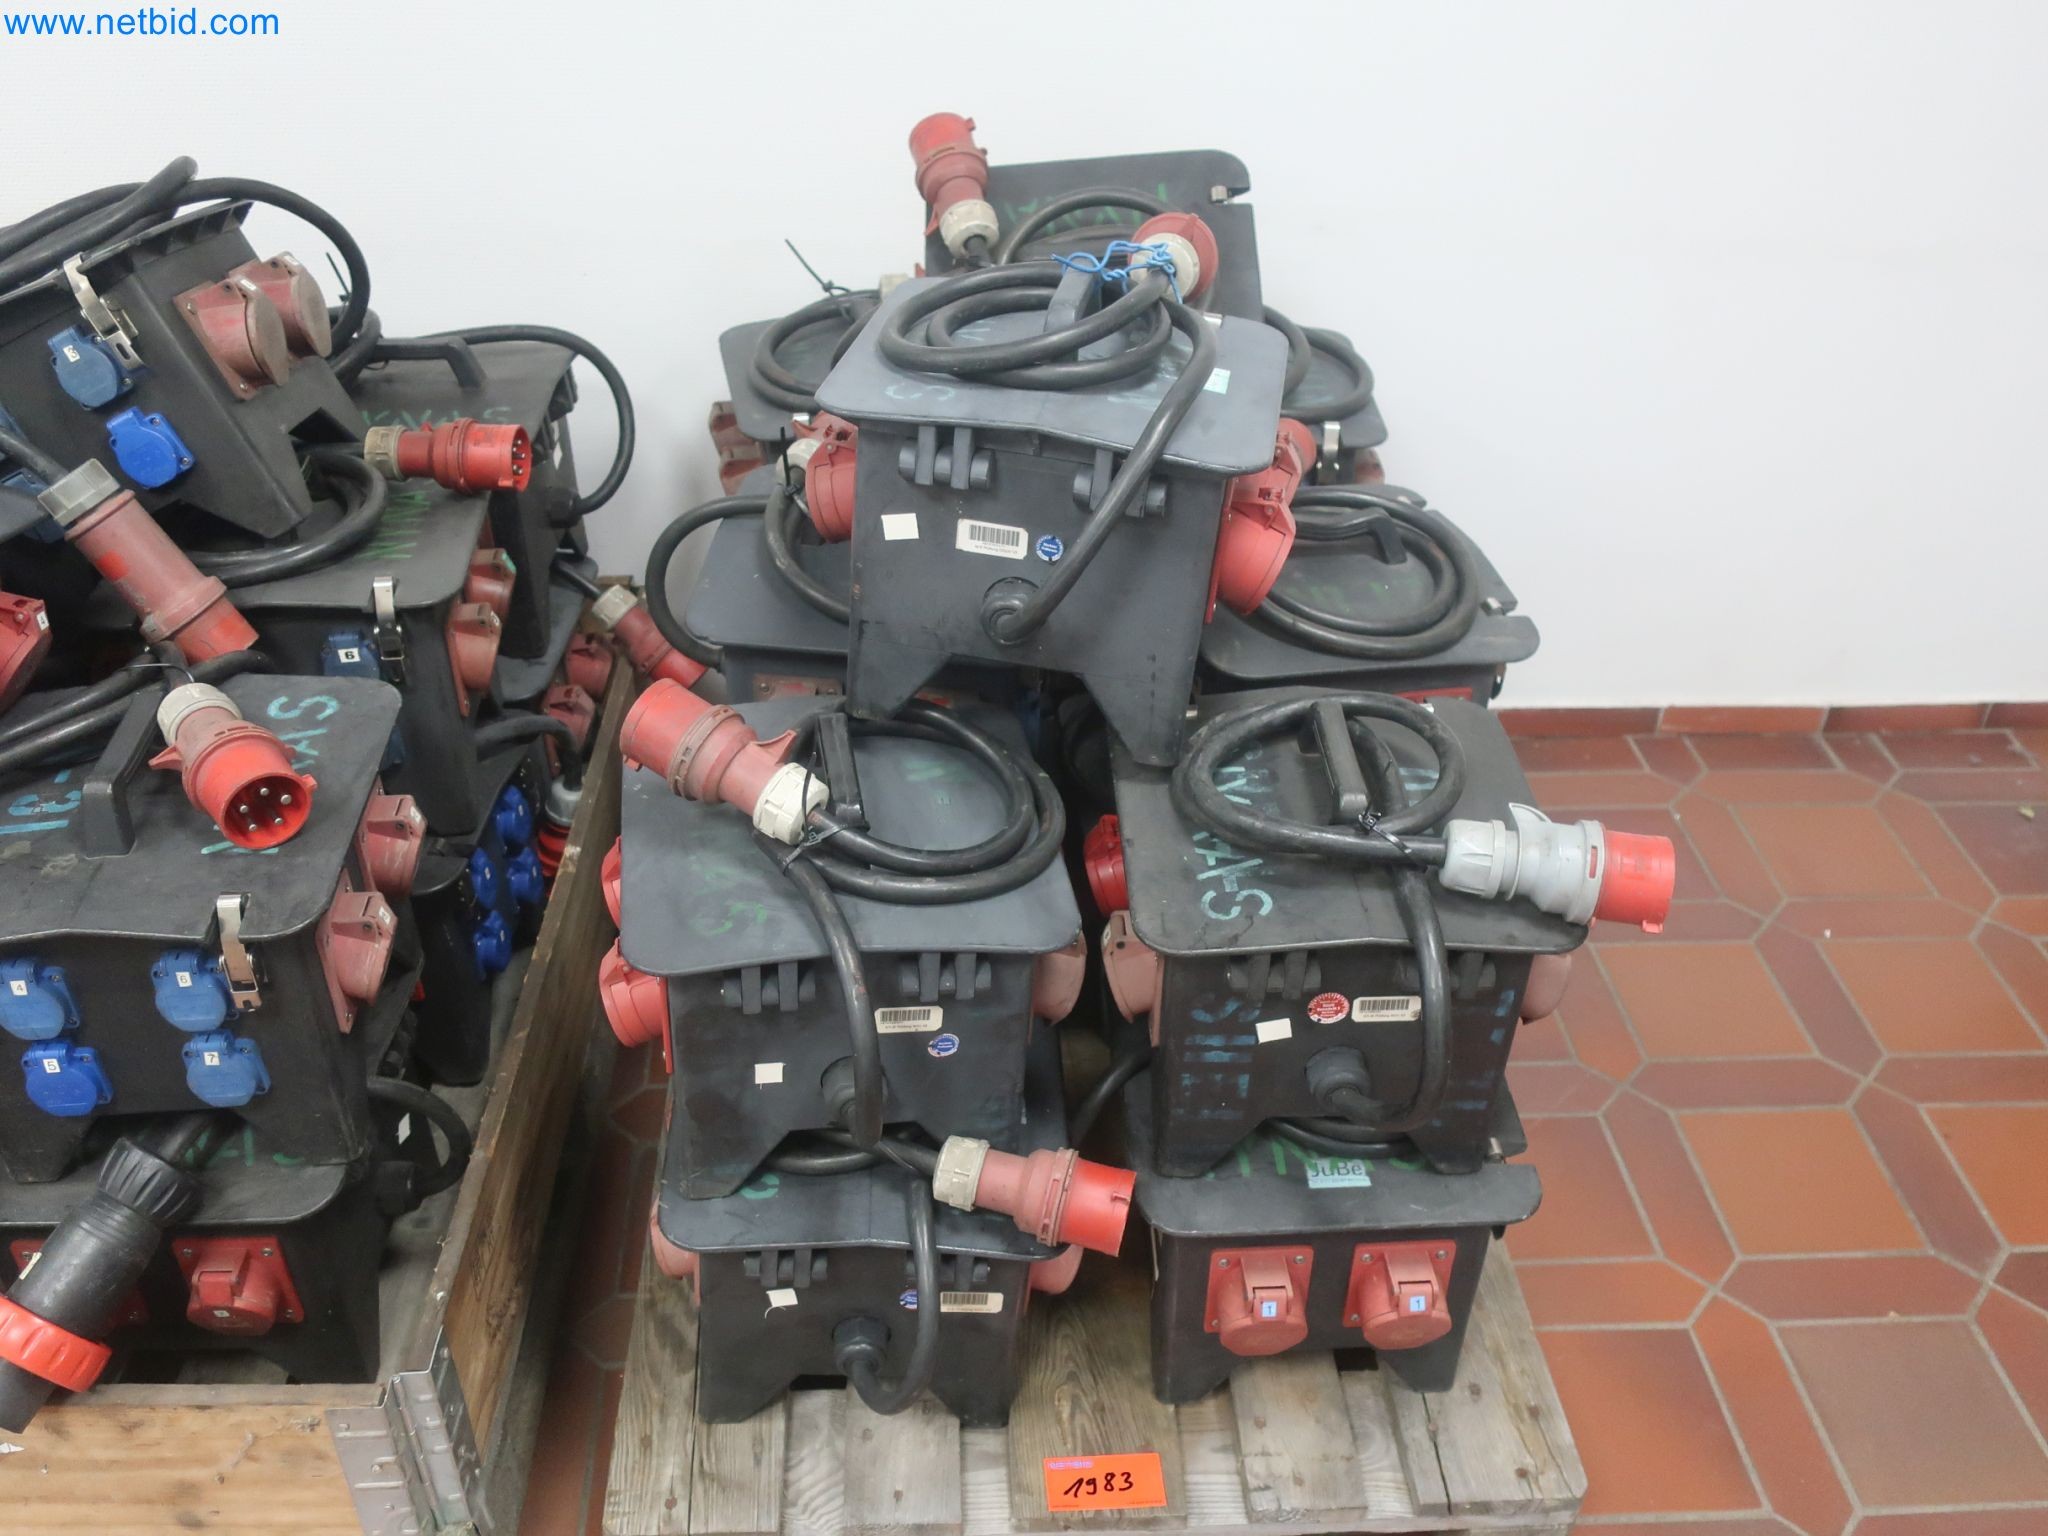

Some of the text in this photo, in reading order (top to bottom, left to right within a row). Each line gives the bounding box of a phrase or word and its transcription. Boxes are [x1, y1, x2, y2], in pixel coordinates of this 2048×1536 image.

[345, 651, 355, 660] 6
[207, 1054, 215, 1063] 7
[47, 1061, 56, 1070] 5
[1063, 1471, 1134, 1498] 1983
